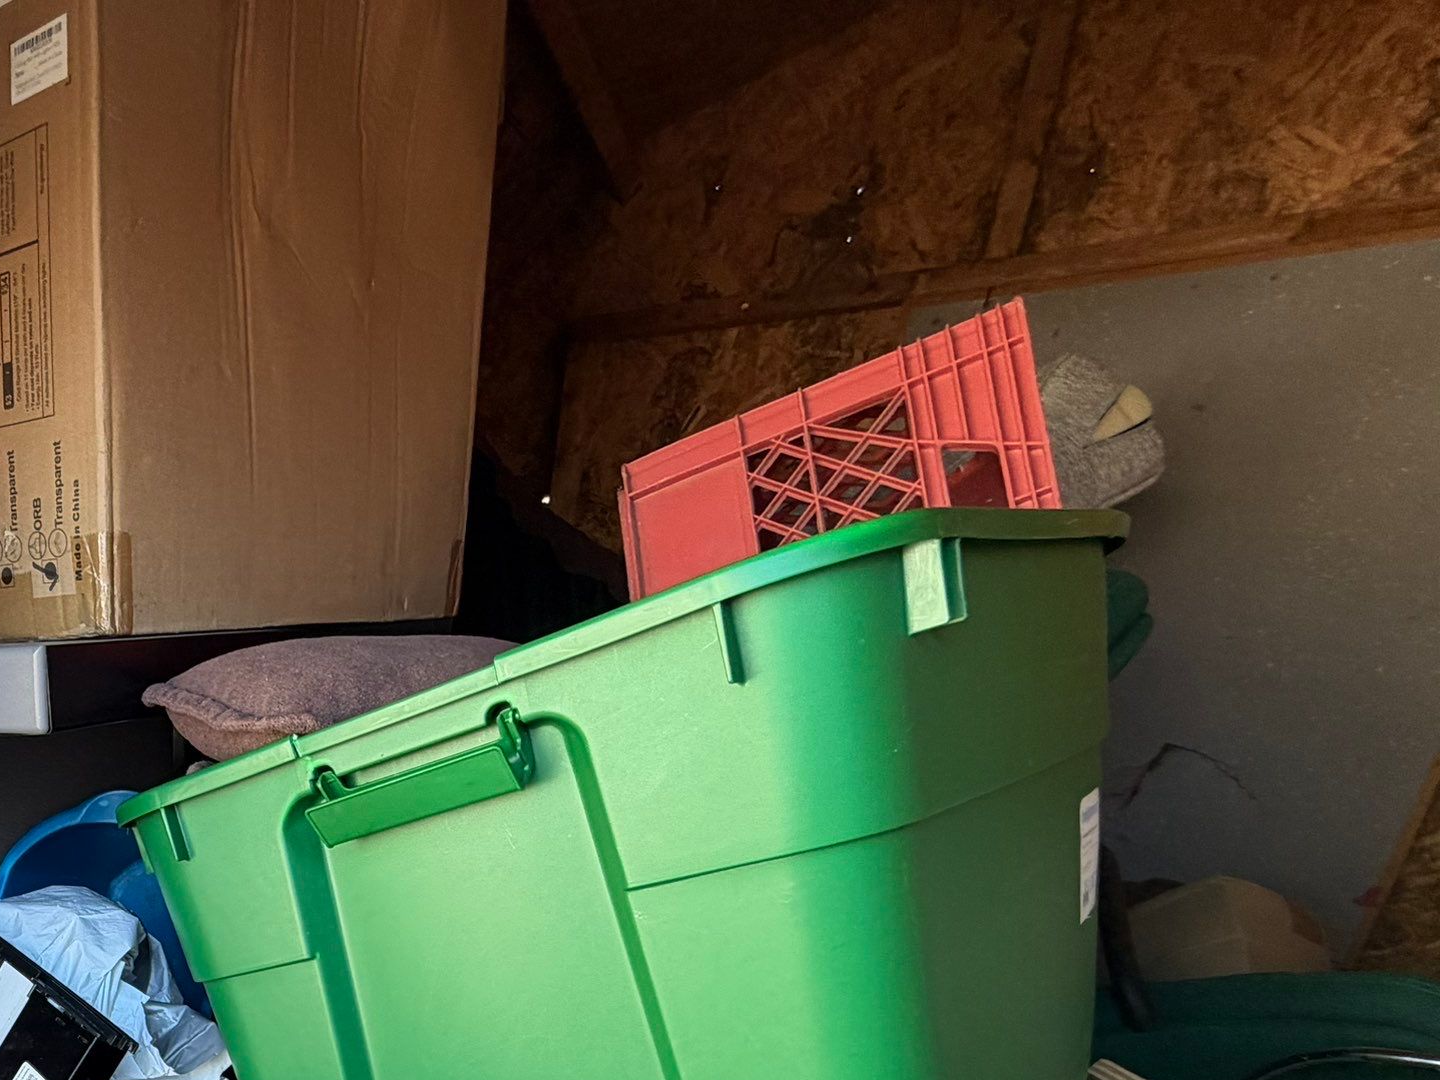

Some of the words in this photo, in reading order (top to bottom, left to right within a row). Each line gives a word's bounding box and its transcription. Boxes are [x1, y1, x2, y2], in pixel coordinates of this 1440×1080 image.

[6, 450, 18, 532] Transparent
[53, 440, 64, 529] Transparent
[72, 479, 80, 522] China
[32, 497, 42, 531] ORB
[73, 543, 83, 581] Made
